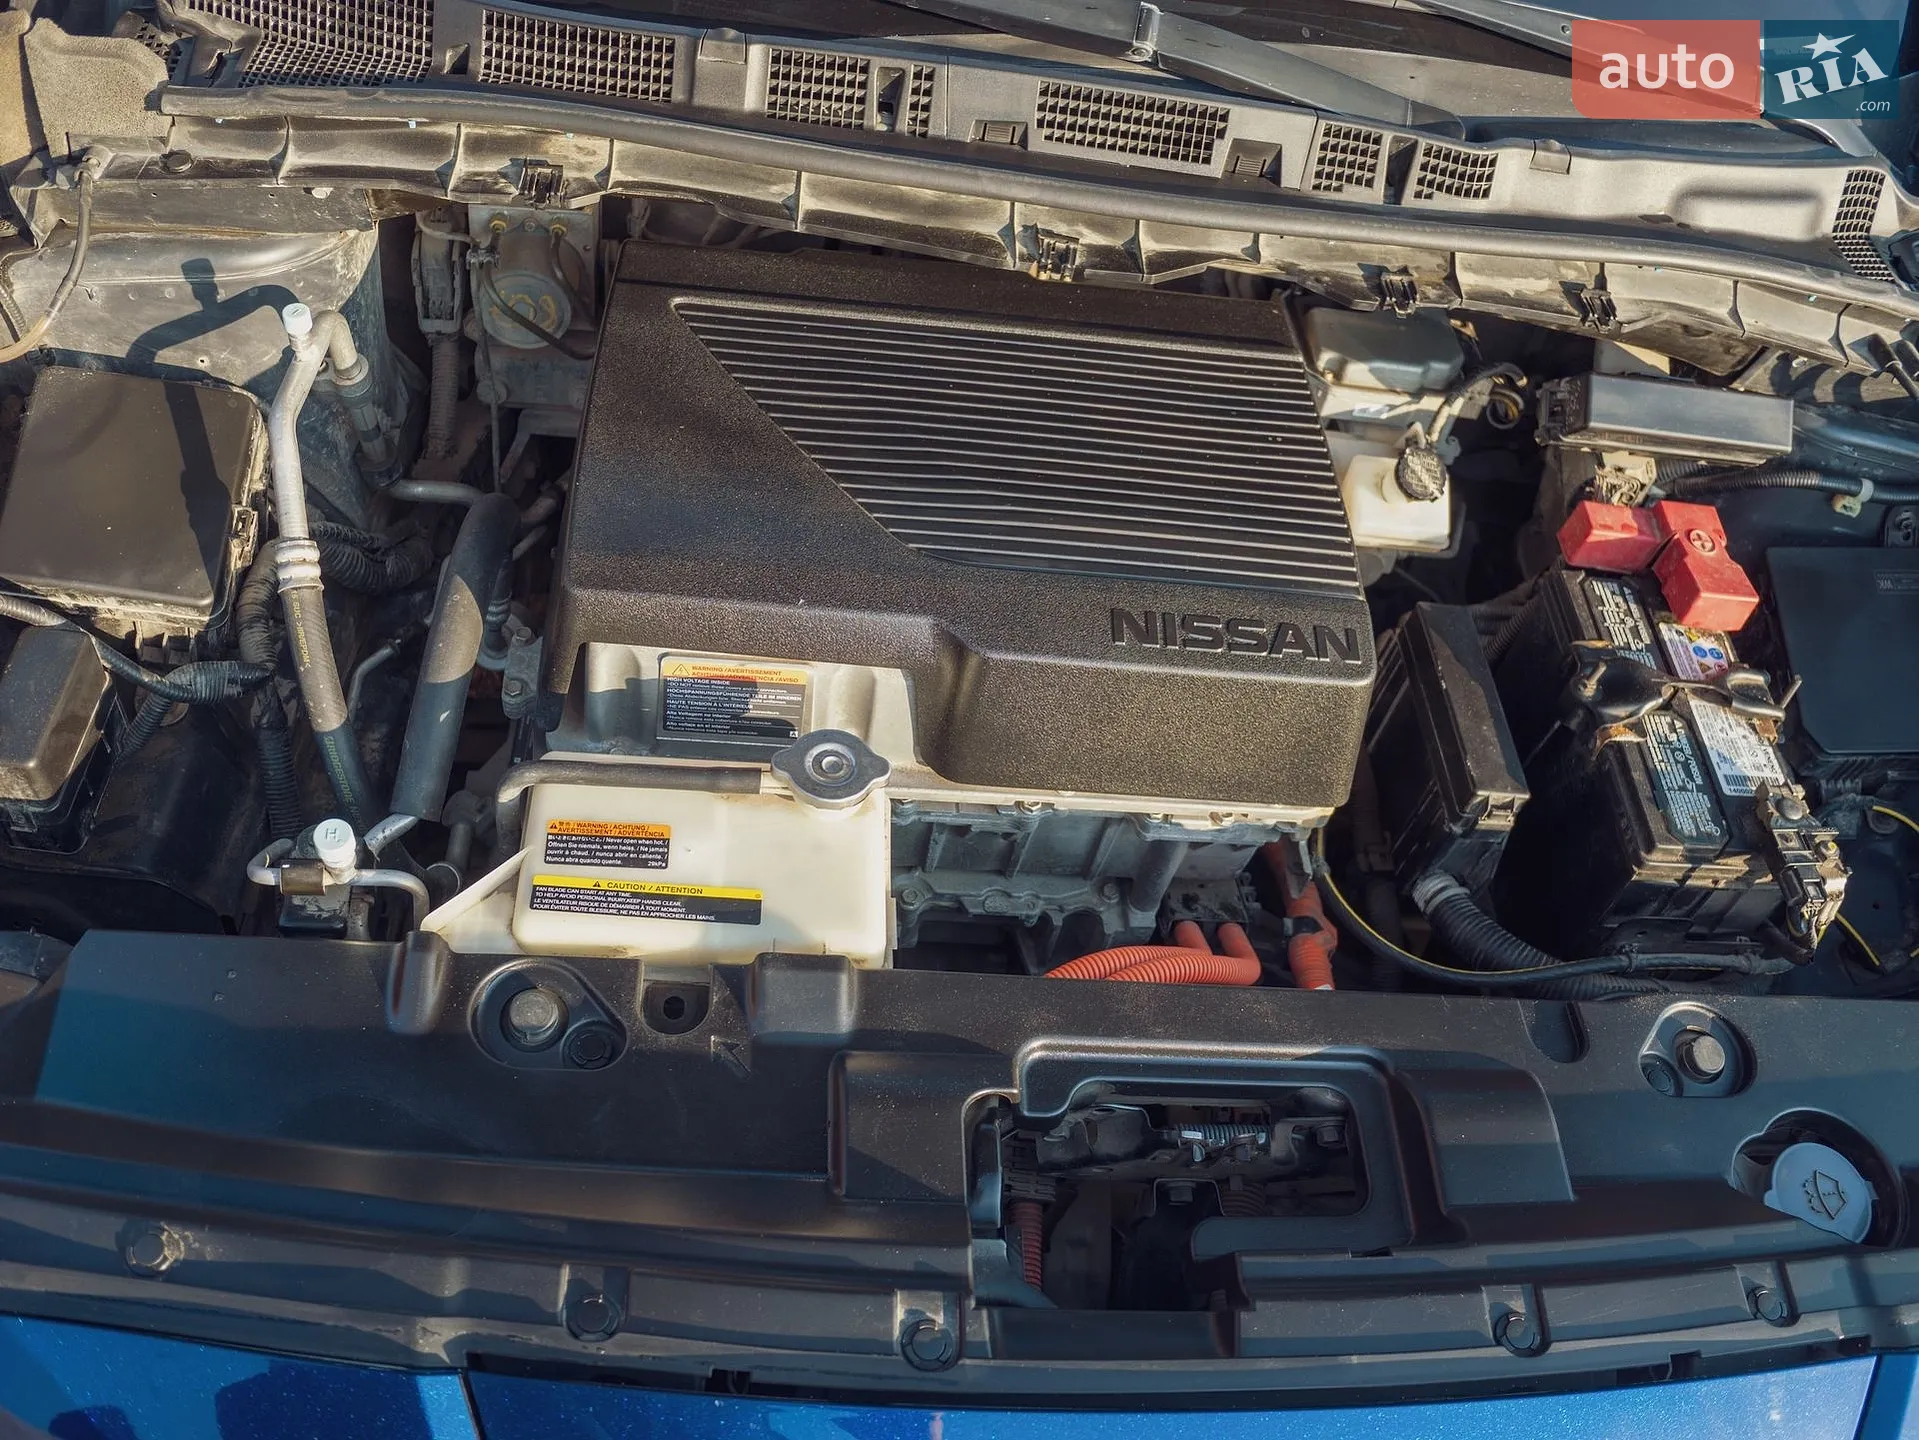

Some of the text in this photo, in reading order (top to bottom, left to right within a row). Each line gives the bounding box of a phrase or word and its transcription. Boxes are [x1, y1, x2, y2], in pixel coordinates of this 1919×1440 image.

[1111, 607, 1363, 665] NISSAN
[558, 827, 613, 835] AVERTISSEMENT
[607, 882, 646, 891] CAUTION
[655, 885, 703, 894] ATTENTION
[650, 911, 685, 919] APPROCHER
